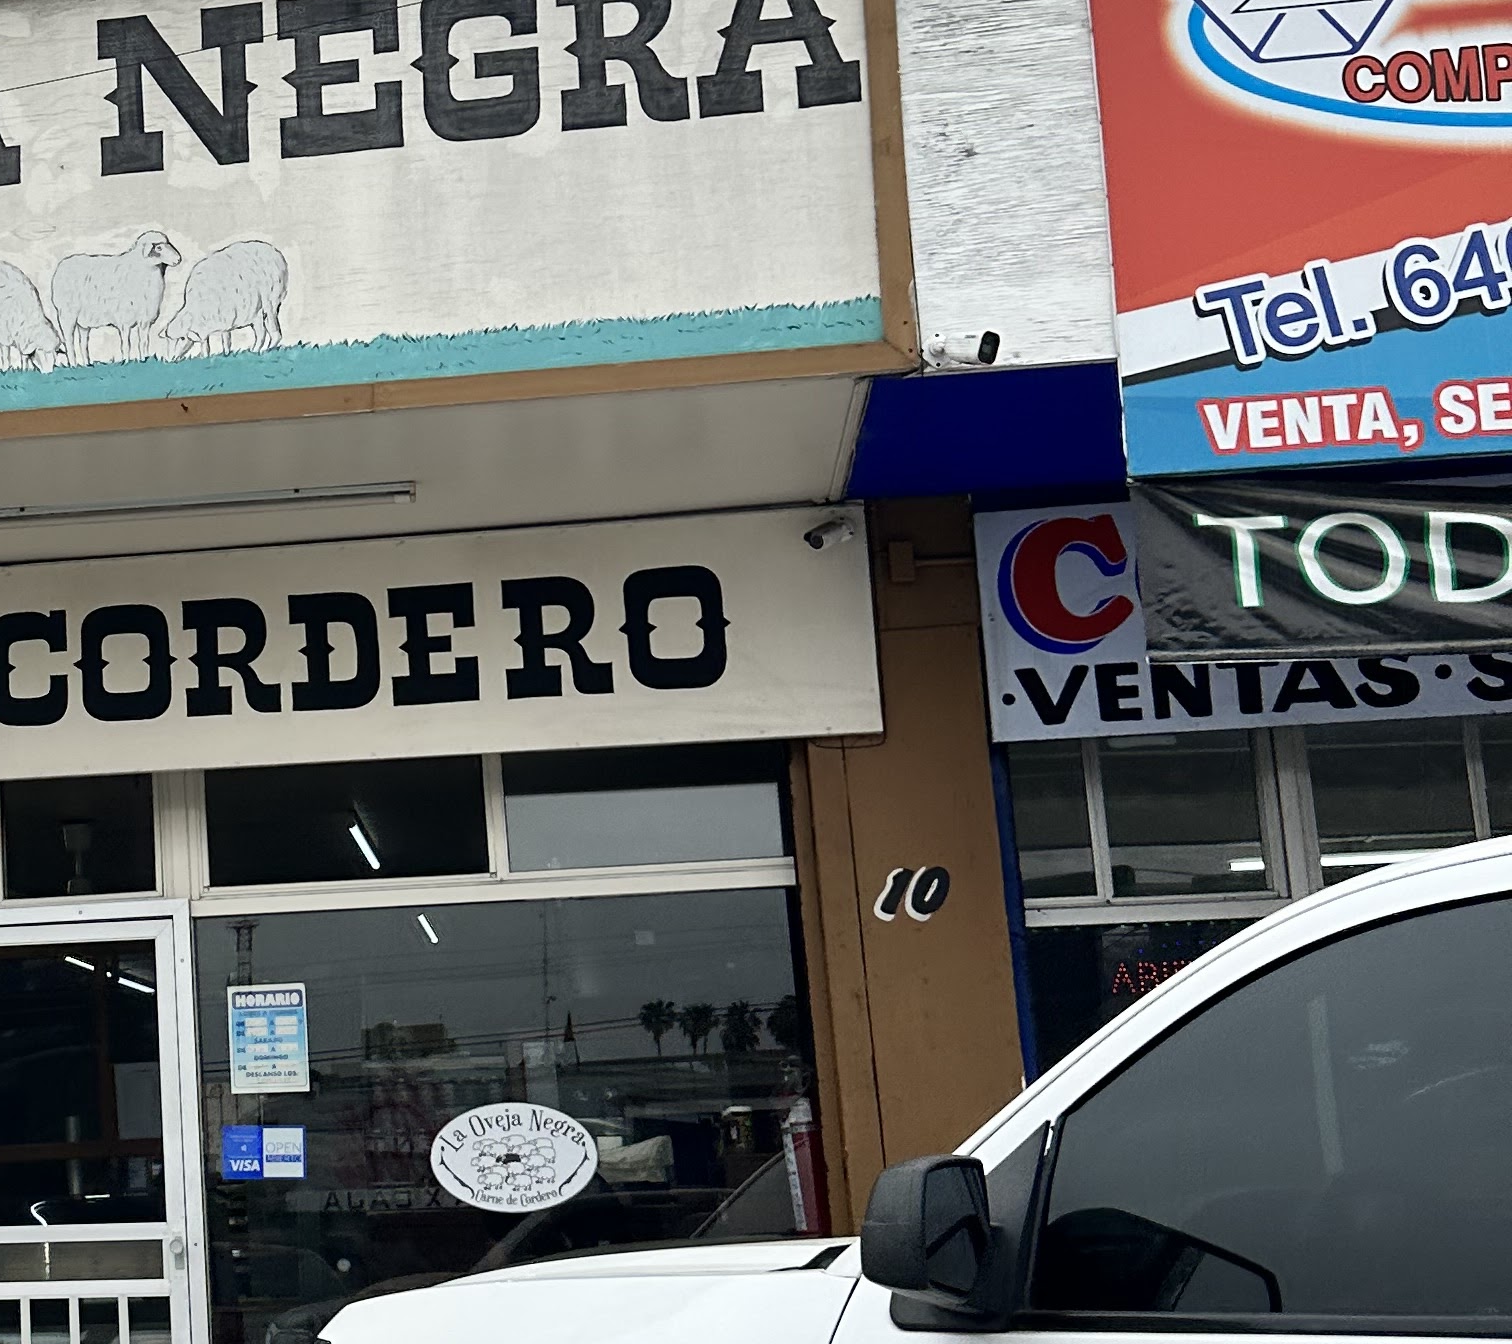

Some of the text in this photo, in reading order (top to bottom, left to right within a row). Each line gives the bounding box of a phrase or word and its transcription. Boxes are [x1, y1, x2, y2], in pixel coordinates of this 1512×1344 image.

[1205, 227, 1512, 358] Tel. 64
[1205, 392, 1418, 449] VENTA,
[874, 865, 950, 922] 10
[235, 992, 300, 1007] HORARIO
[439, 1109, 585, 1152] La Oveja Negra
[265, 1141, 302, 1154] OPEN
[229, 1159, 261, 1172] VISA
[475, 1189, 558, 1207] Carne de Cordero
